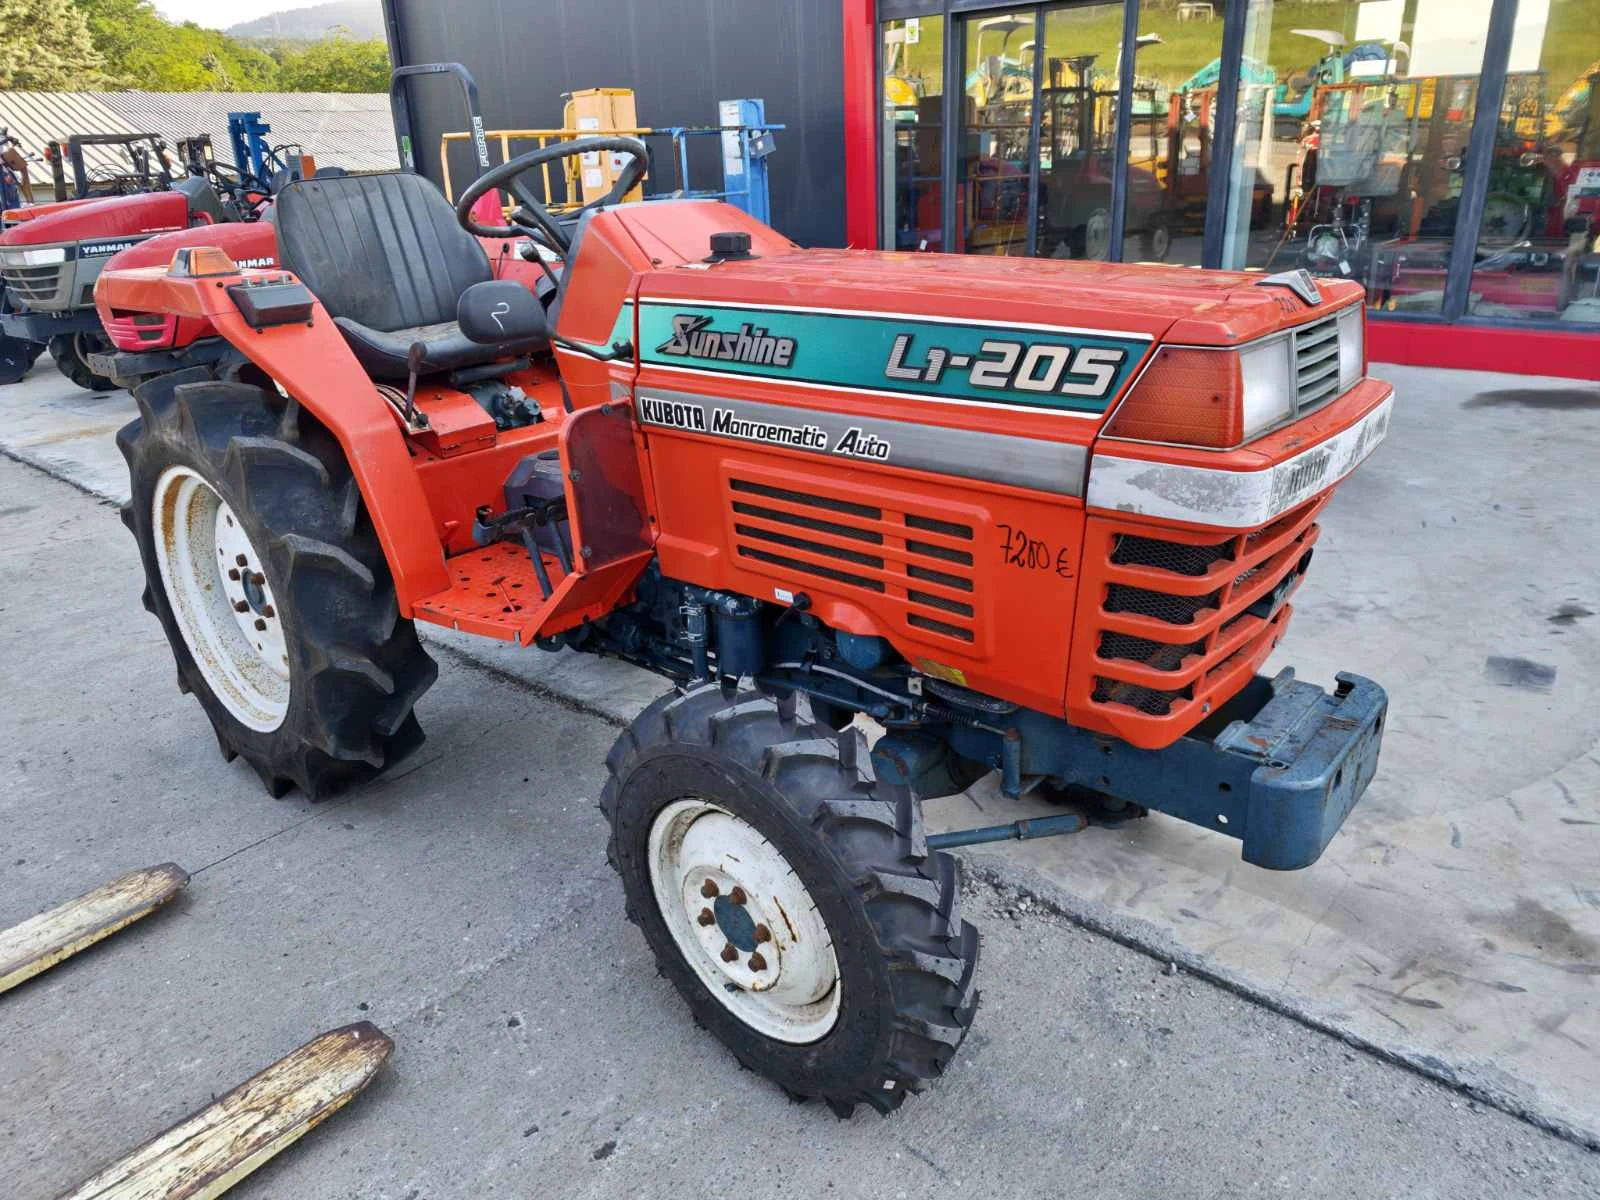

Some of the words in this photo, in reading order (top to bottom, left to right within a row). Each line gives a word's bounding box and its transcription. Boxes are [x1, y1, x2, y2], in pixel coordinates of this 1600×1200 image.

[473, 116, 489, 167] FORTE
[232, 257, 274, 269] ANMAR
[655, 314, 796, 368] Sunshine
[885, 334, 1127, 397] L1-205
[640, 397, 706, 430] KUBOTA
[712, 408, 827, 449] Monroematic
[835, 428, 891, 460] Auto
